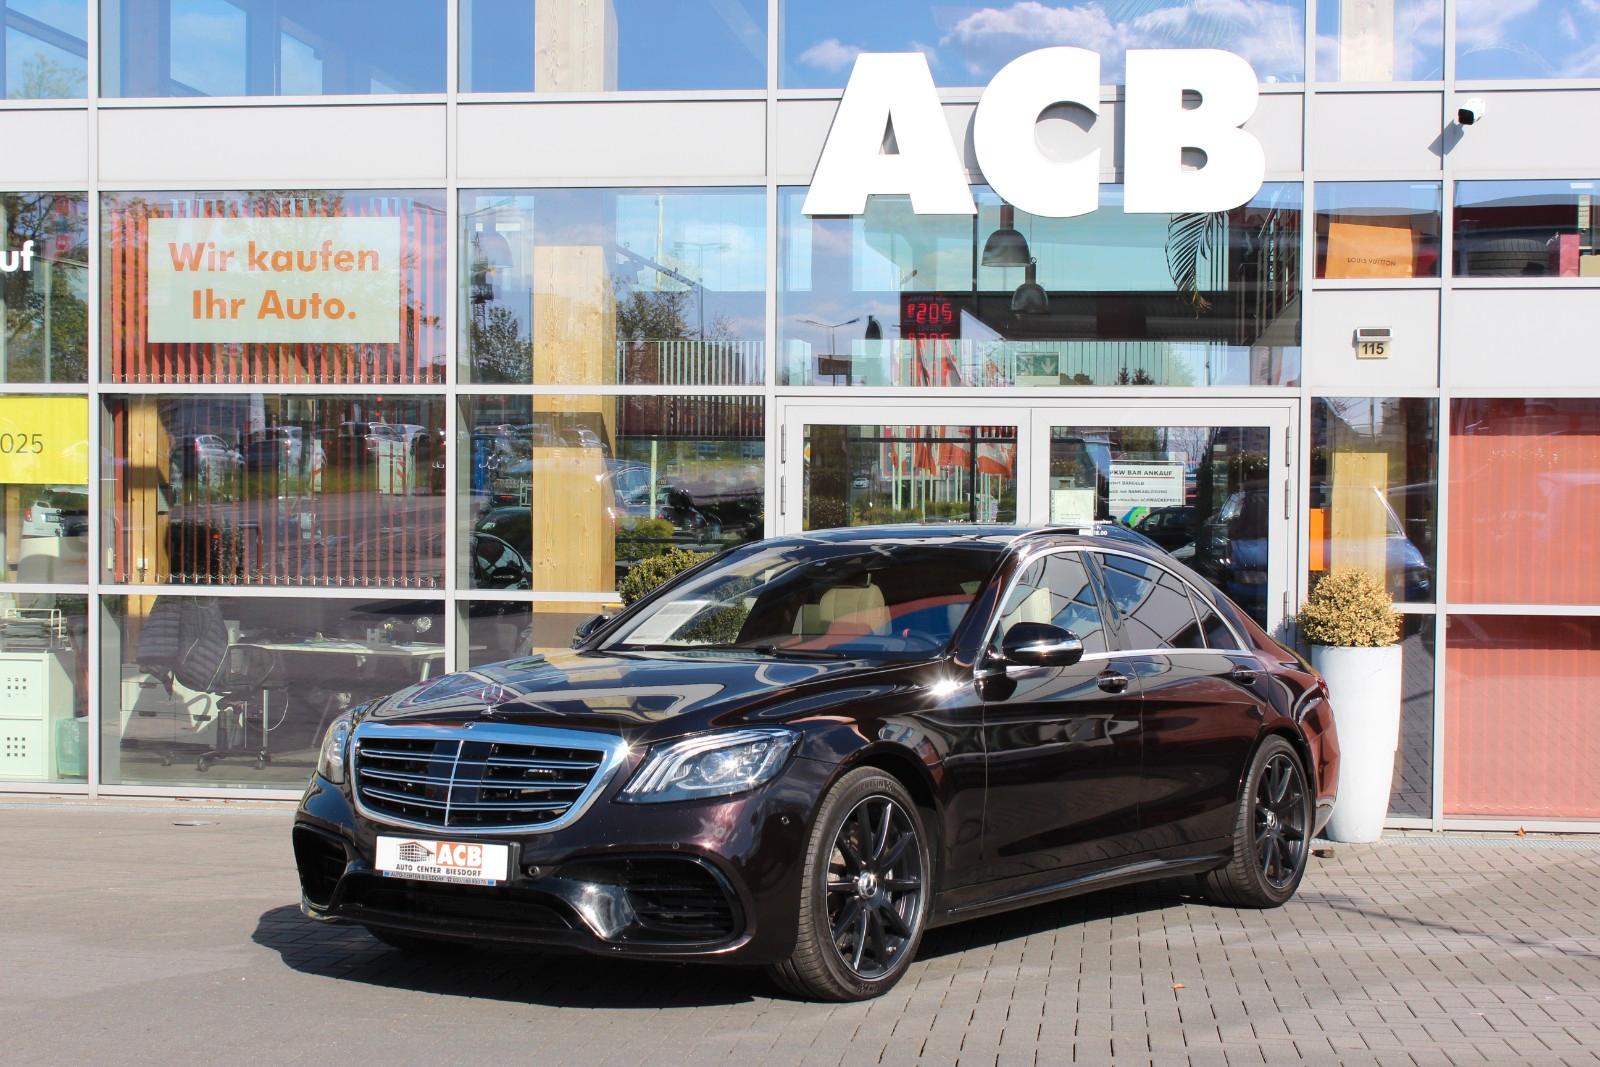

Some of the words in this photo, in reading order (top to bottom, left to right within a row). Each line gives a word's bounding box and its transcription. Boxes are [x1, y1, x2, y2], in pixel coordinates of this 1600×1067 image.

[801, 46, 1266, 217] ACB
[168, 242, 234, 272] Wir
[248, 240, 380, 272] kaufen
[1368, 258, 1396, 266] VUITTON
[192, 288, 246, 320] Ihr
[257, 289, 357, 320] Auto.
[1362, 342, 1384, 354] 115
[438, 844, 482, 867] ACB
[396, 863, 413, 871] AUTO
[416, 865, 442, 874] CENTER
[445, 867, 482, 877] BIESDORF
